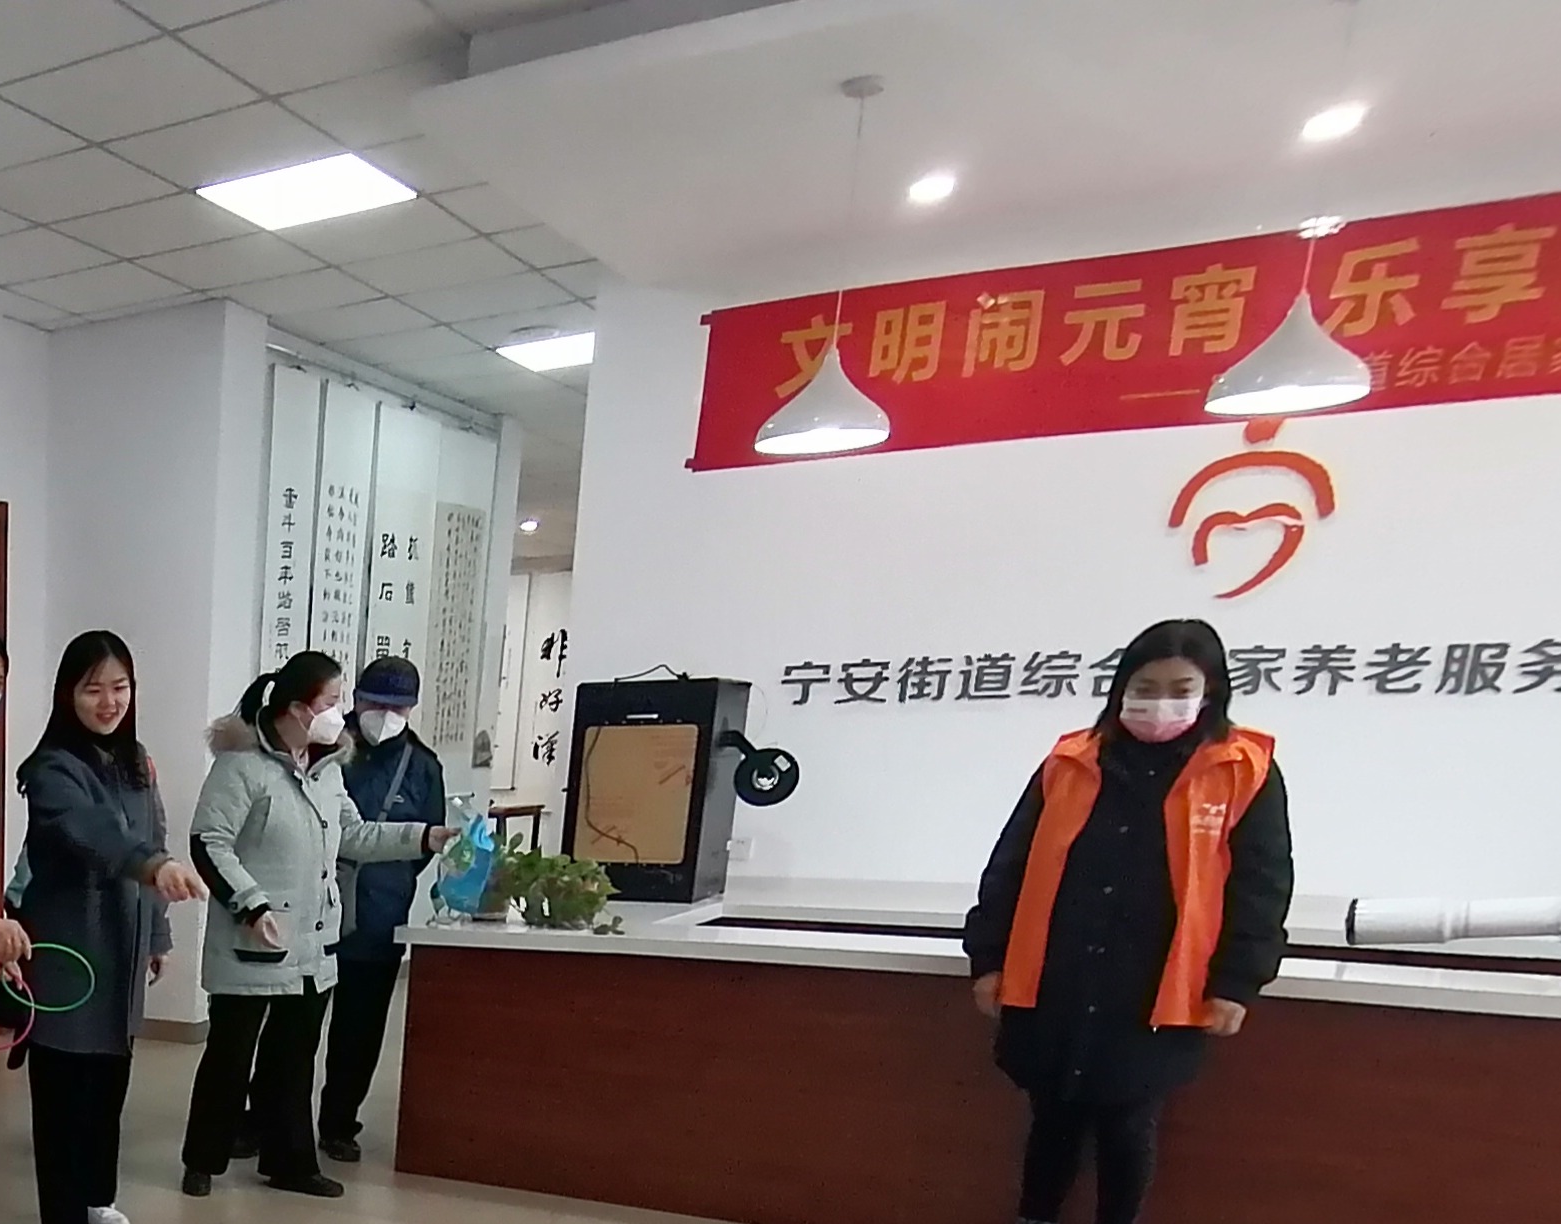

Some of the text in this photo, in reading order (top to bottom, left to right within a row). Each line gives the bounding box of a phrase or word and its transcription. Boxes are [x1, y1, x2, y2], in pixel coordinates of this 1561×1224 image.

[774, 222, 1557, 398] 文明闹元宵 乐享
